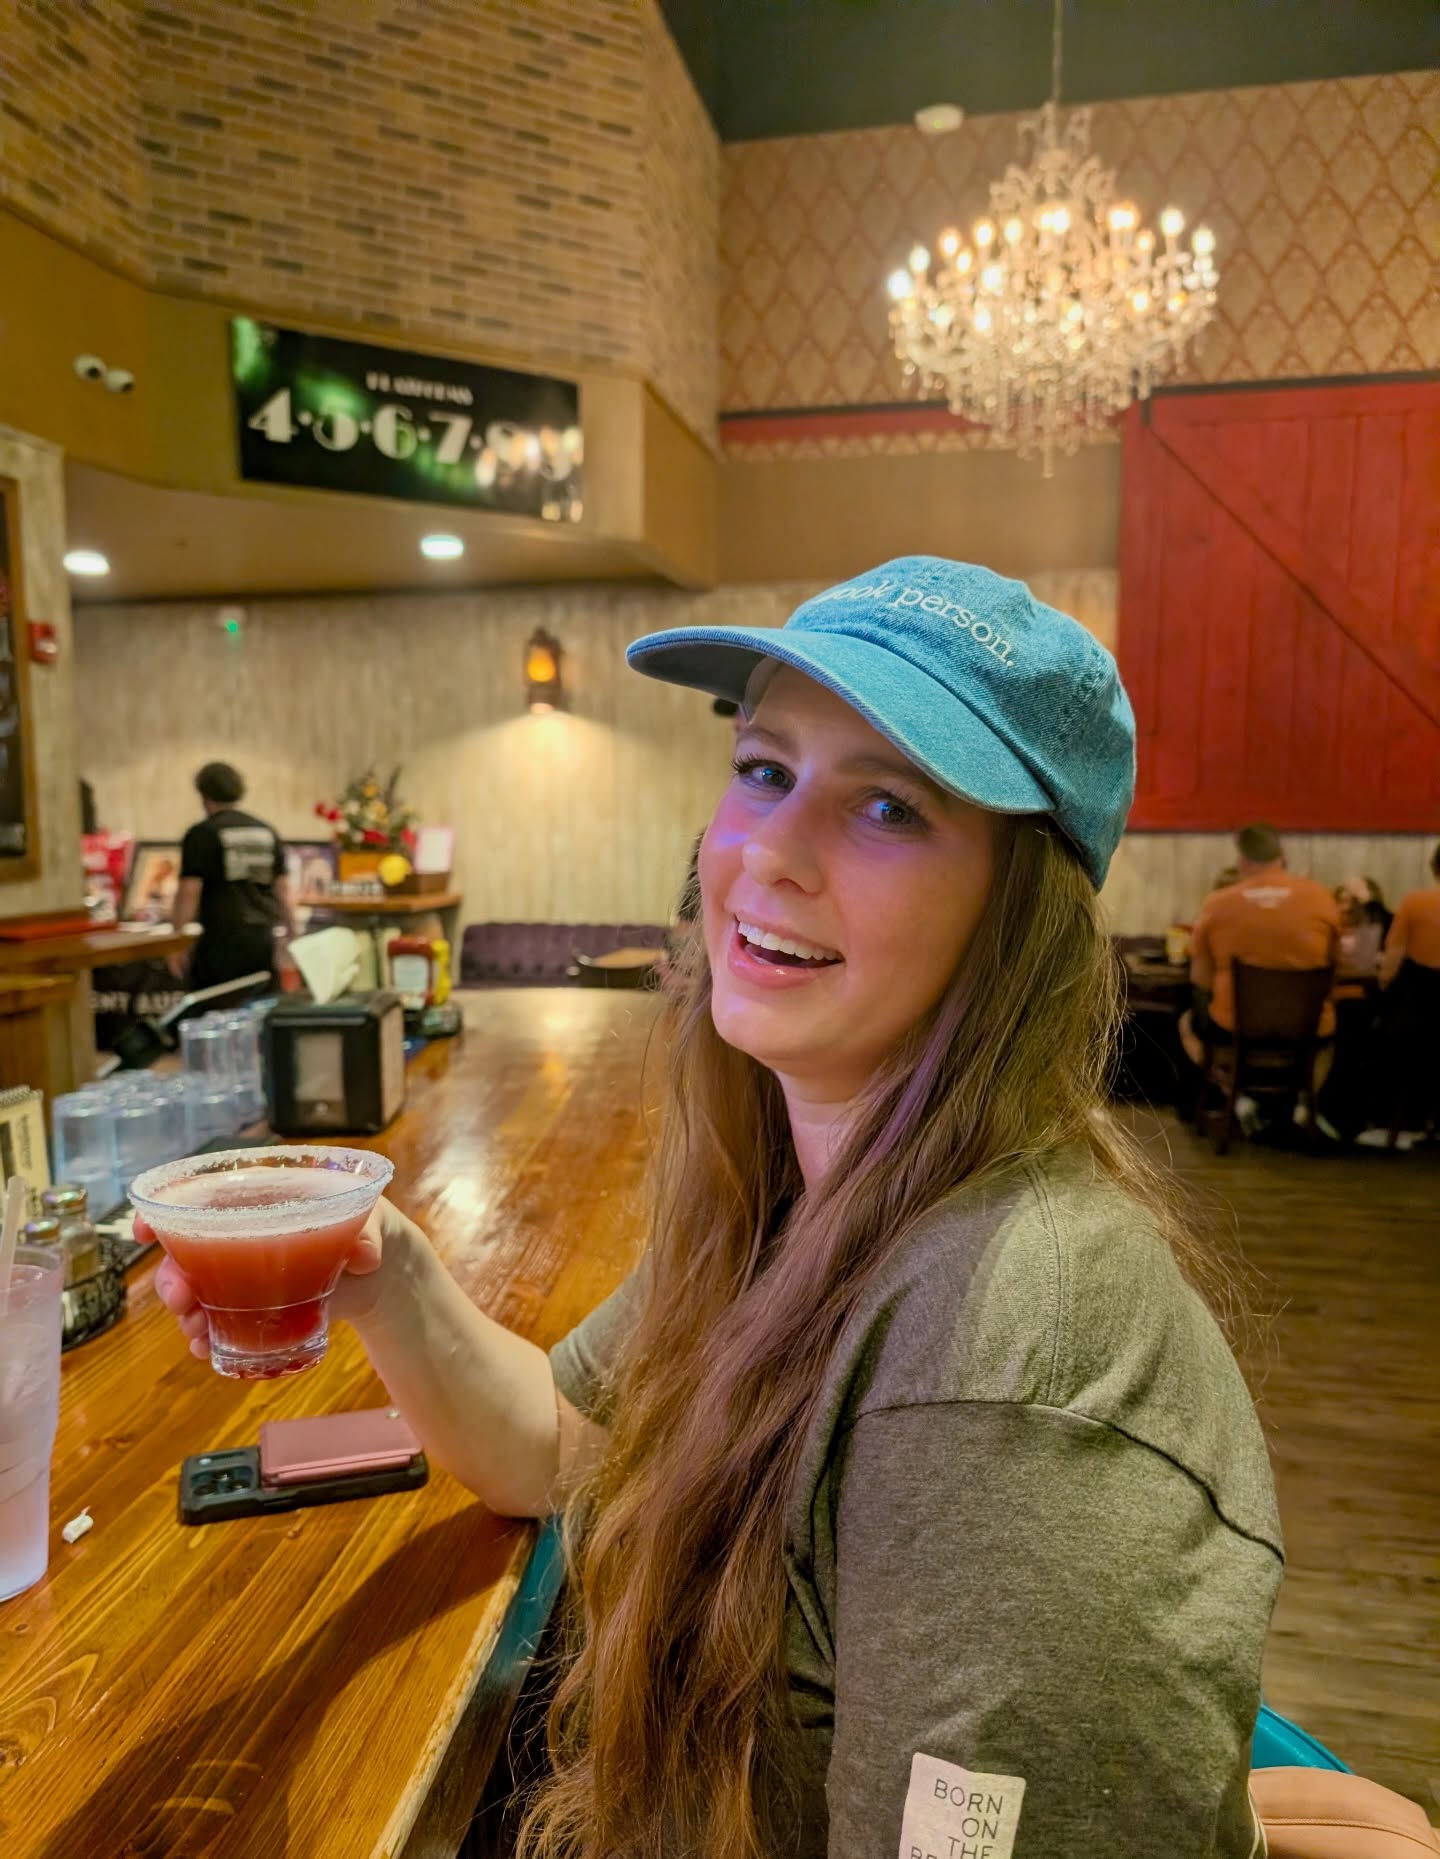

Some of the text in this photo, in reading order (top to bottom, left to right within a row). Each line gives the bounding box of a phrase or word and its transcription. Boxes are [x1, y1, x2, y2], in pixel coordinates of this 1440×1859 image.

[813, 580, 1015, 667] ook person.
[934, 1779, 1003, 1814] BORN
[962, 1818, 998, 1839] ON
